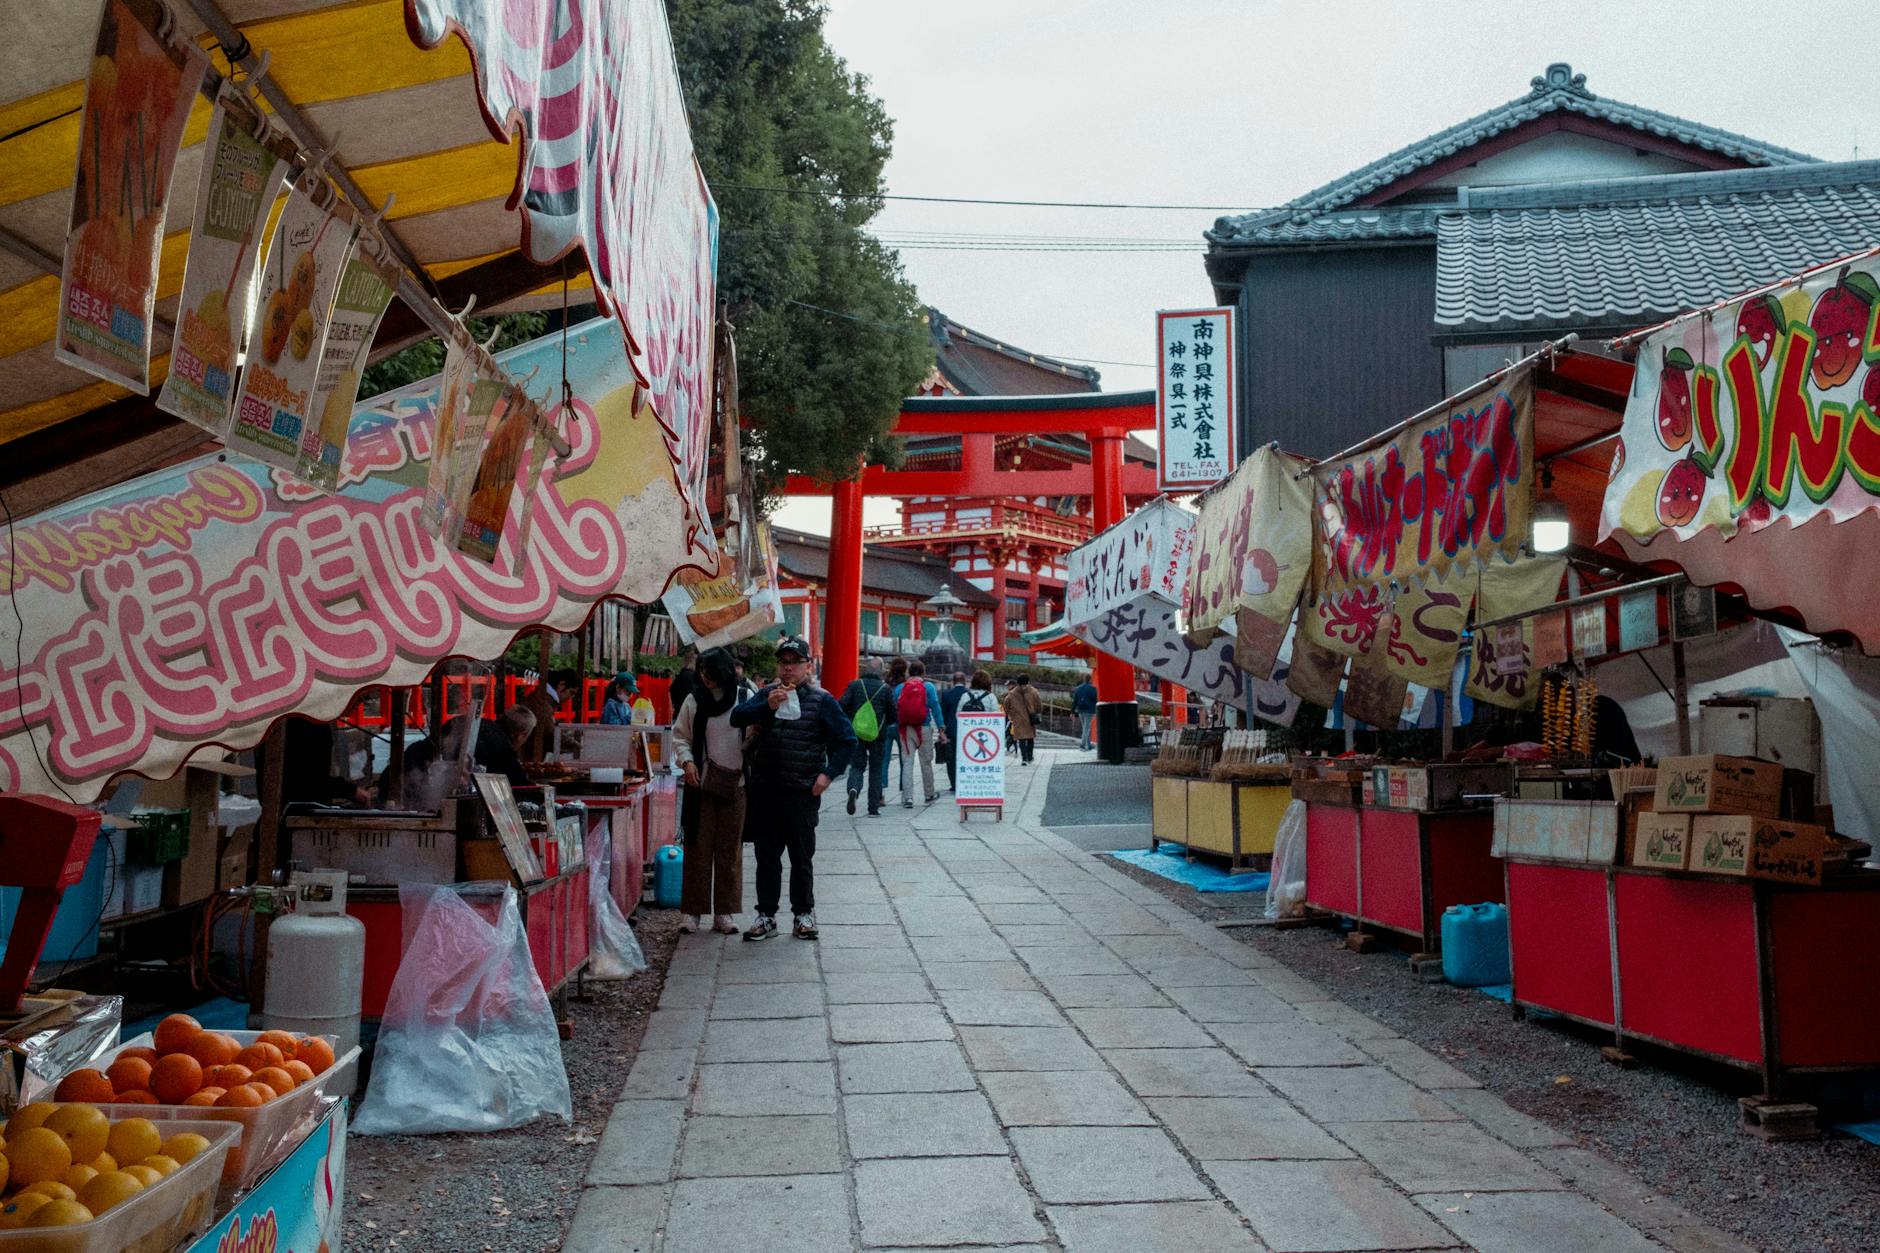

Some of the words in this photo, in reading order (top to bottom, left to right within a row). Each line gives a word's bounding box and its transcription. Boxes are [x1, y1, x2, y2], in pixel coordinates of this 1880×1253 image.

[1169, 340, 1188, 430] 神祭具一式
